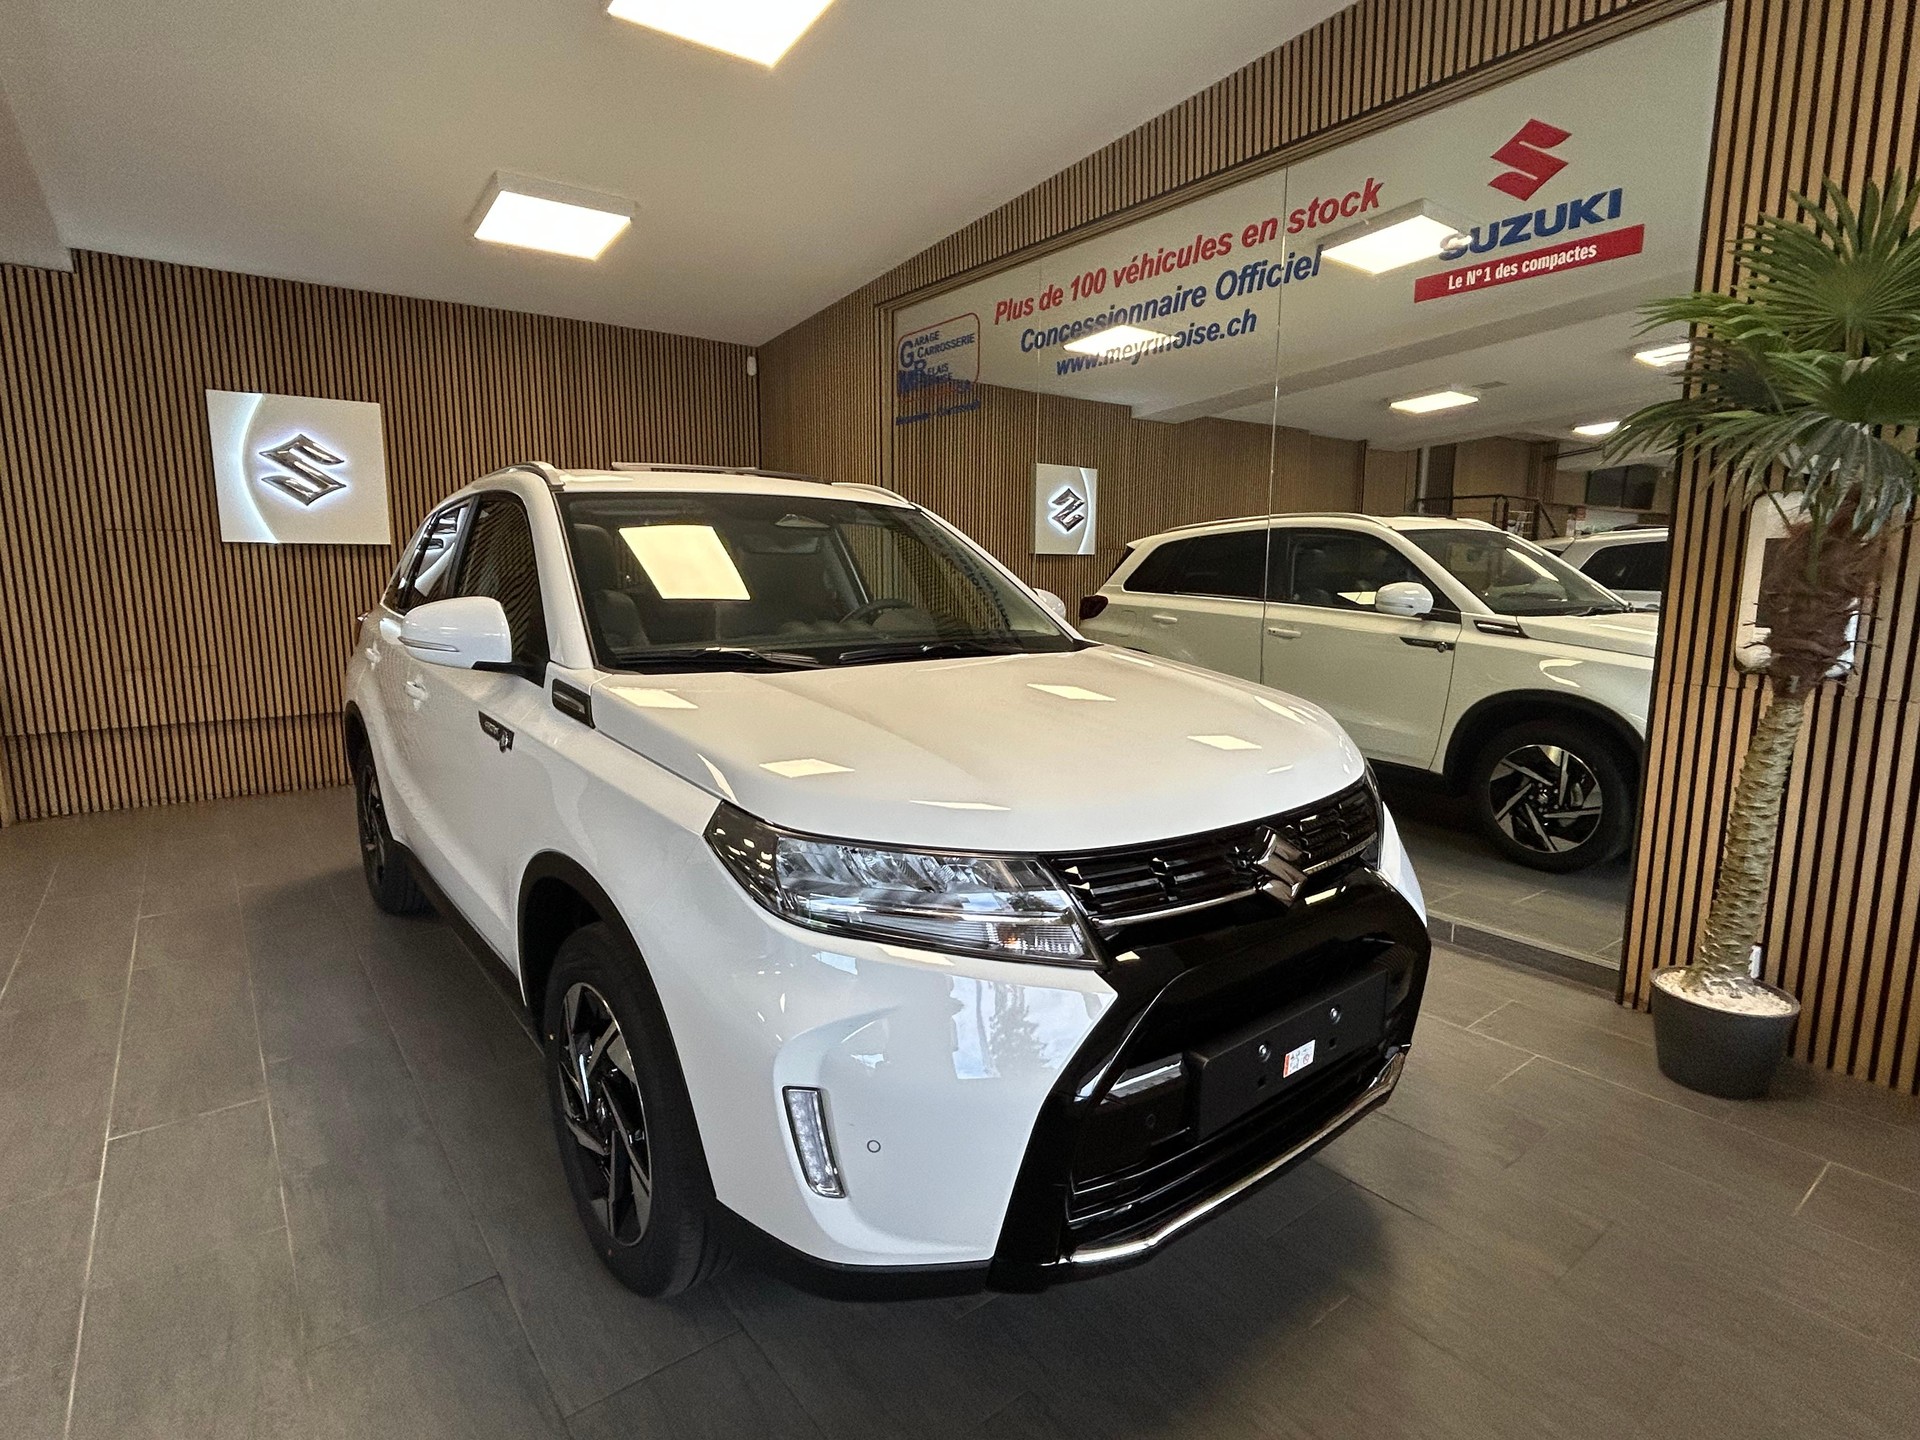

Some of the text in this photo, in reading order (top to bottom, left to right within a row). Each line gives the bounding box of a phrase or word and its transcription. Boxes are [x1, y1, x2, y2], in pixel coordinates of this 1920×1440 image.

[994, 177, 1384, 325] Plus de 100 véhicules en stock
[1438, 188, 1623, 262] SUZUKI
[1448, 274, 1462, 290] Le
[1495, 262, 1518, 280] des
[1522, 243, 1597, 273] compactes
[1021, 245, 1325, 353] Concessionnaire Officiel
